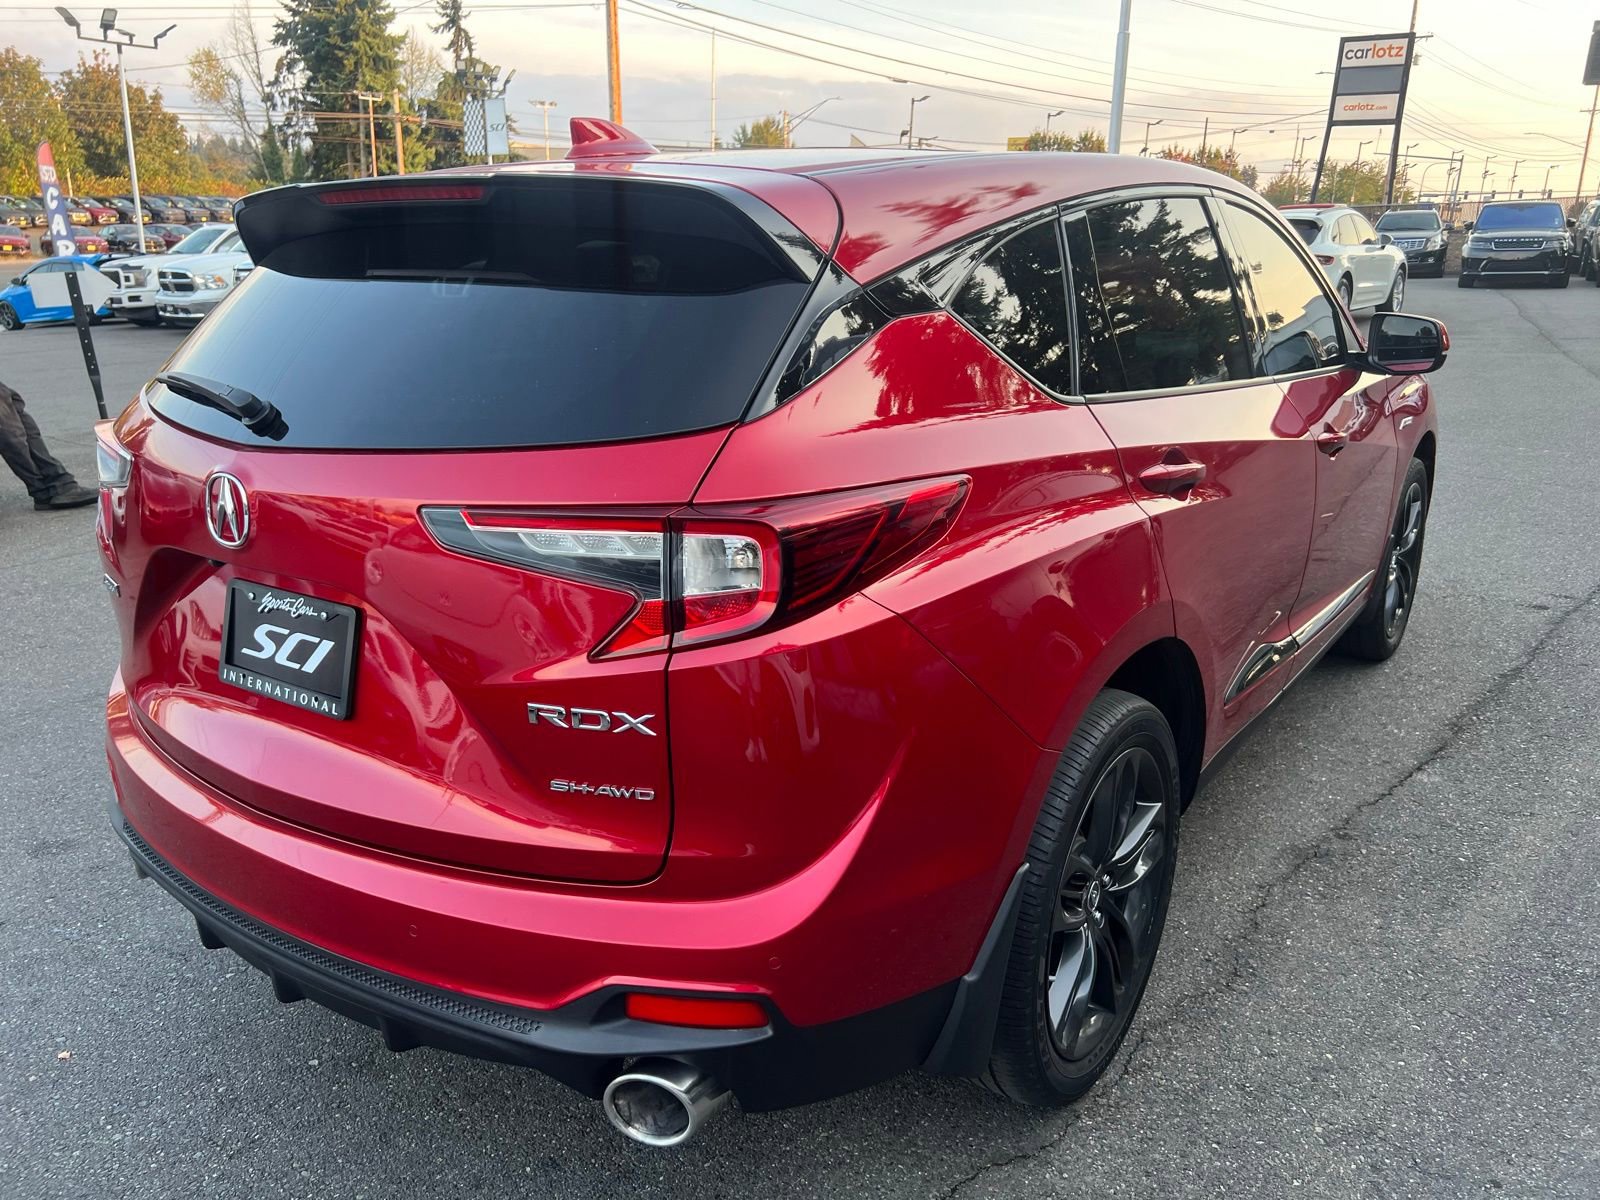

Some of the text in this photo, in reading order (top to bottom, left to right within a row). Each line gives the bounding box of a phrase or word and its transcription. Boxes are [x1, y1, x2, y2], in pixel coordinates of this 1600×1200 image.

[1344, 43, 1404, 60] carlotz
[1343, 102, 1388, 112] carlotz.com
[488, 122, 506, 133] SCI
[257, 591, 318, 618] Sports Cars
[240, 623, 335, 674] SCI
[223, 668, 339, 716] INTERNATIONAL
[526, 702, 657, 737] RDX
[549, 778, 656, 801] SH-AWD
